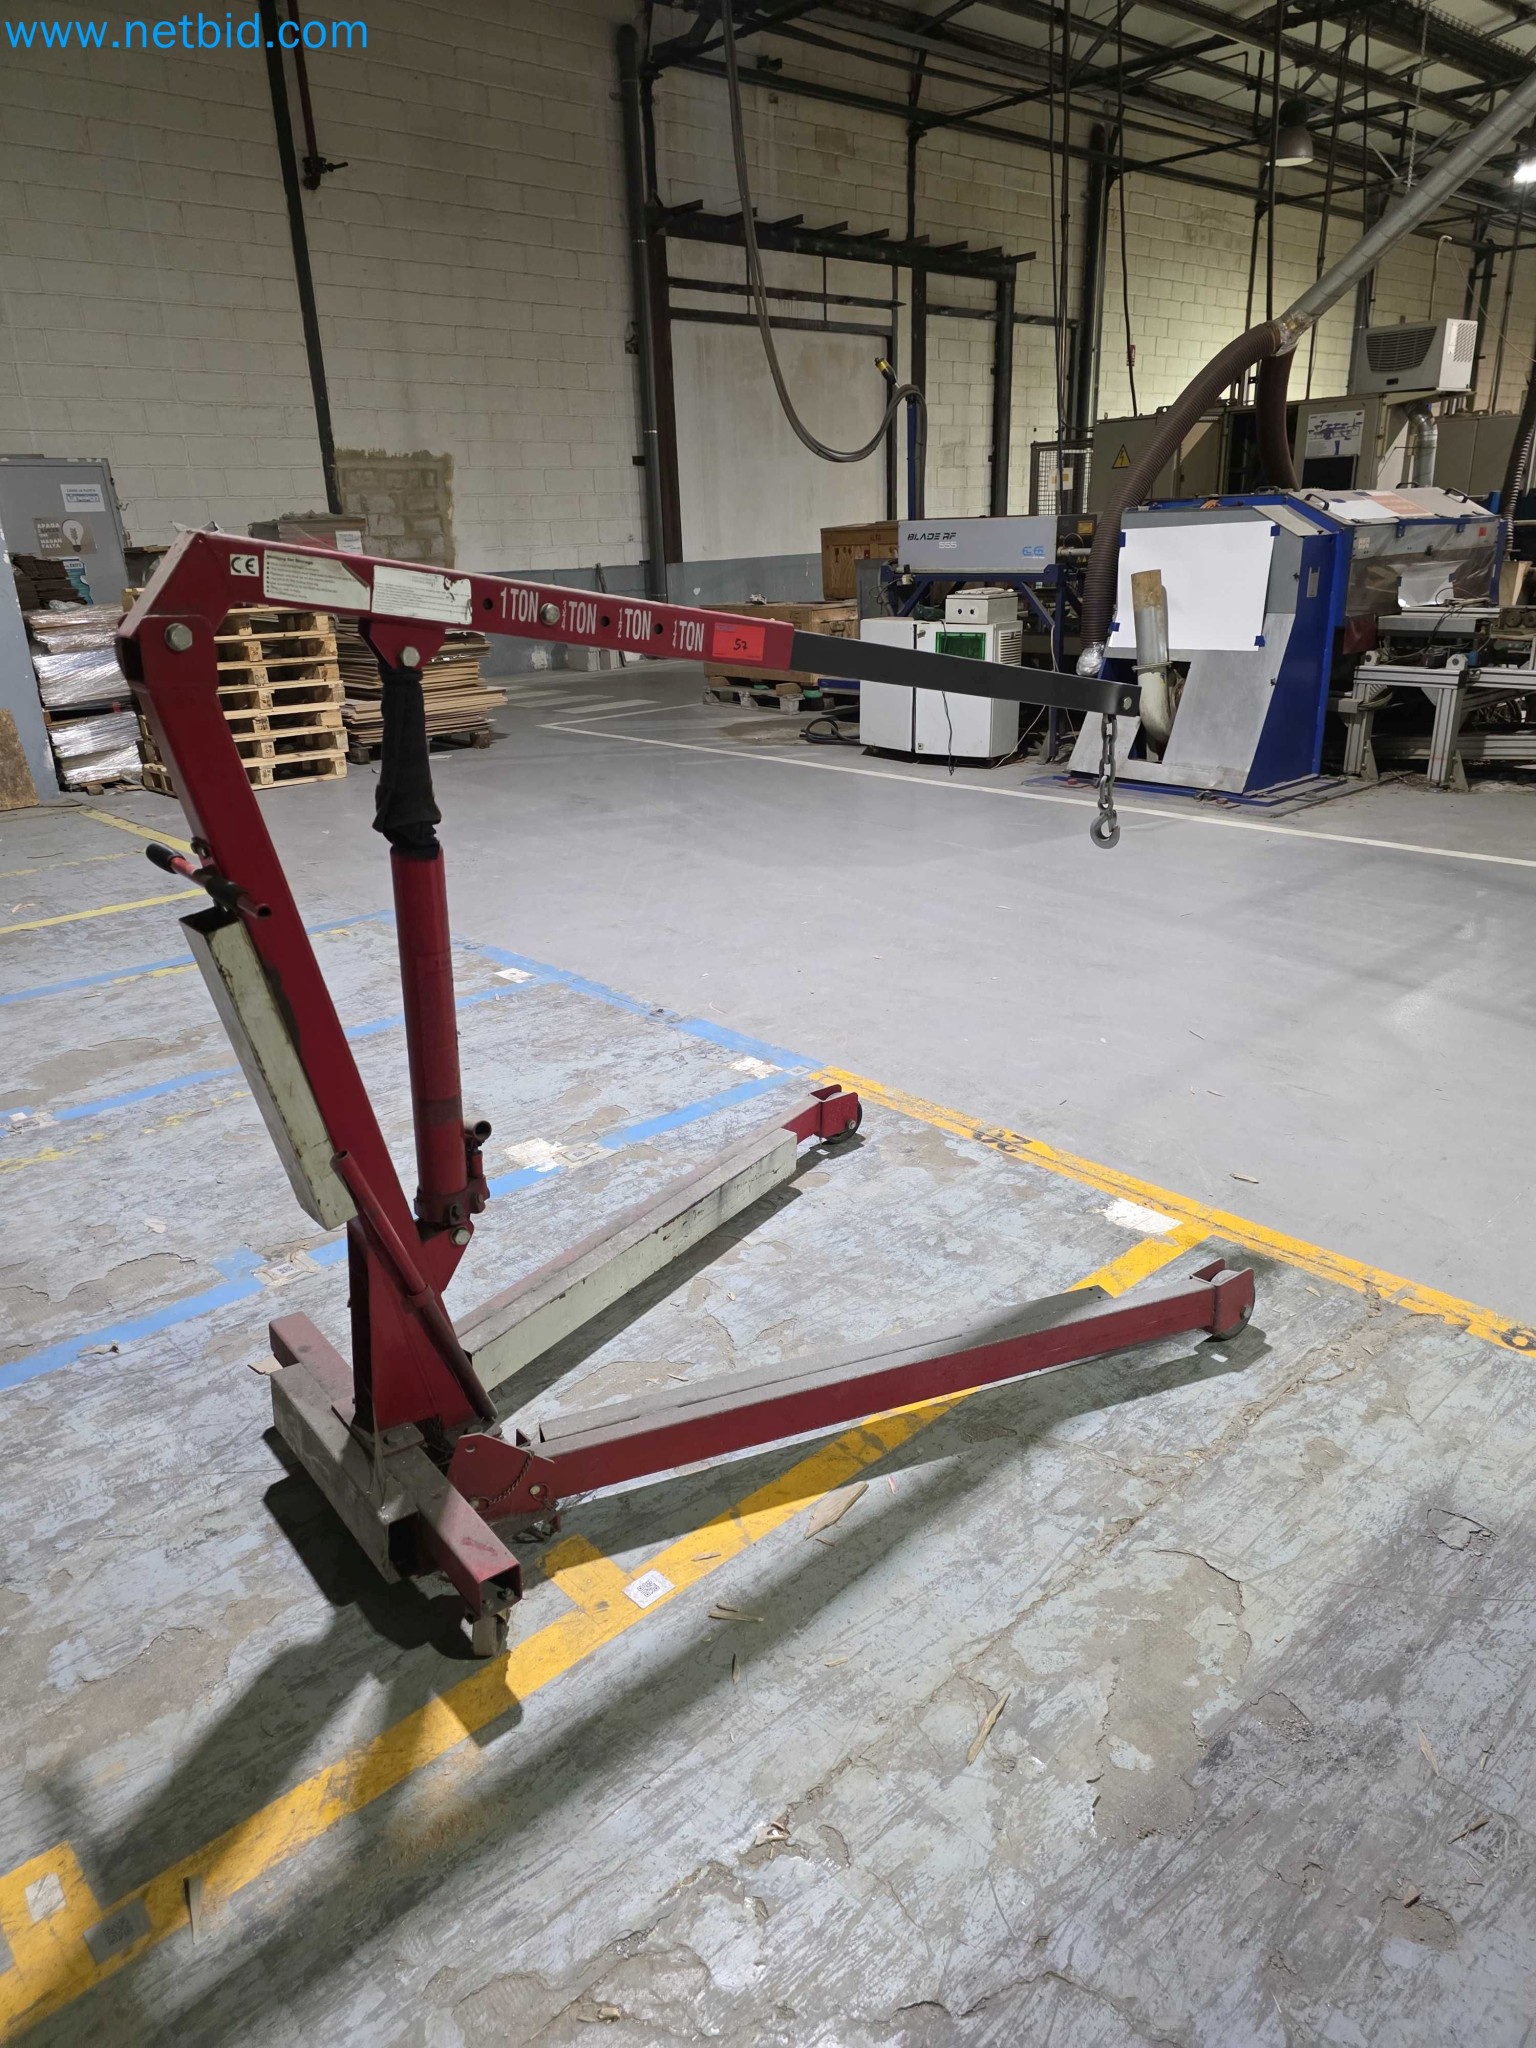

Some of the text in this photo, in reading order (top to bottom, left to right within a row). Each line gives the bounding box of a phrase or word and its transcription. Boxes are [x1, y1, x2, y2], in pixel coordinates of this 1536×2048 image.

[907, 533, 941, 541] BLADE
[231, 556, 256, 574] CE
[500, 587, 507, 619] 1
[510, 588, 539, 623] TON
[568, 601, 597, 635] TON
[624, 608, 651, 641] TON
[679, 620, 705, 652] TON
